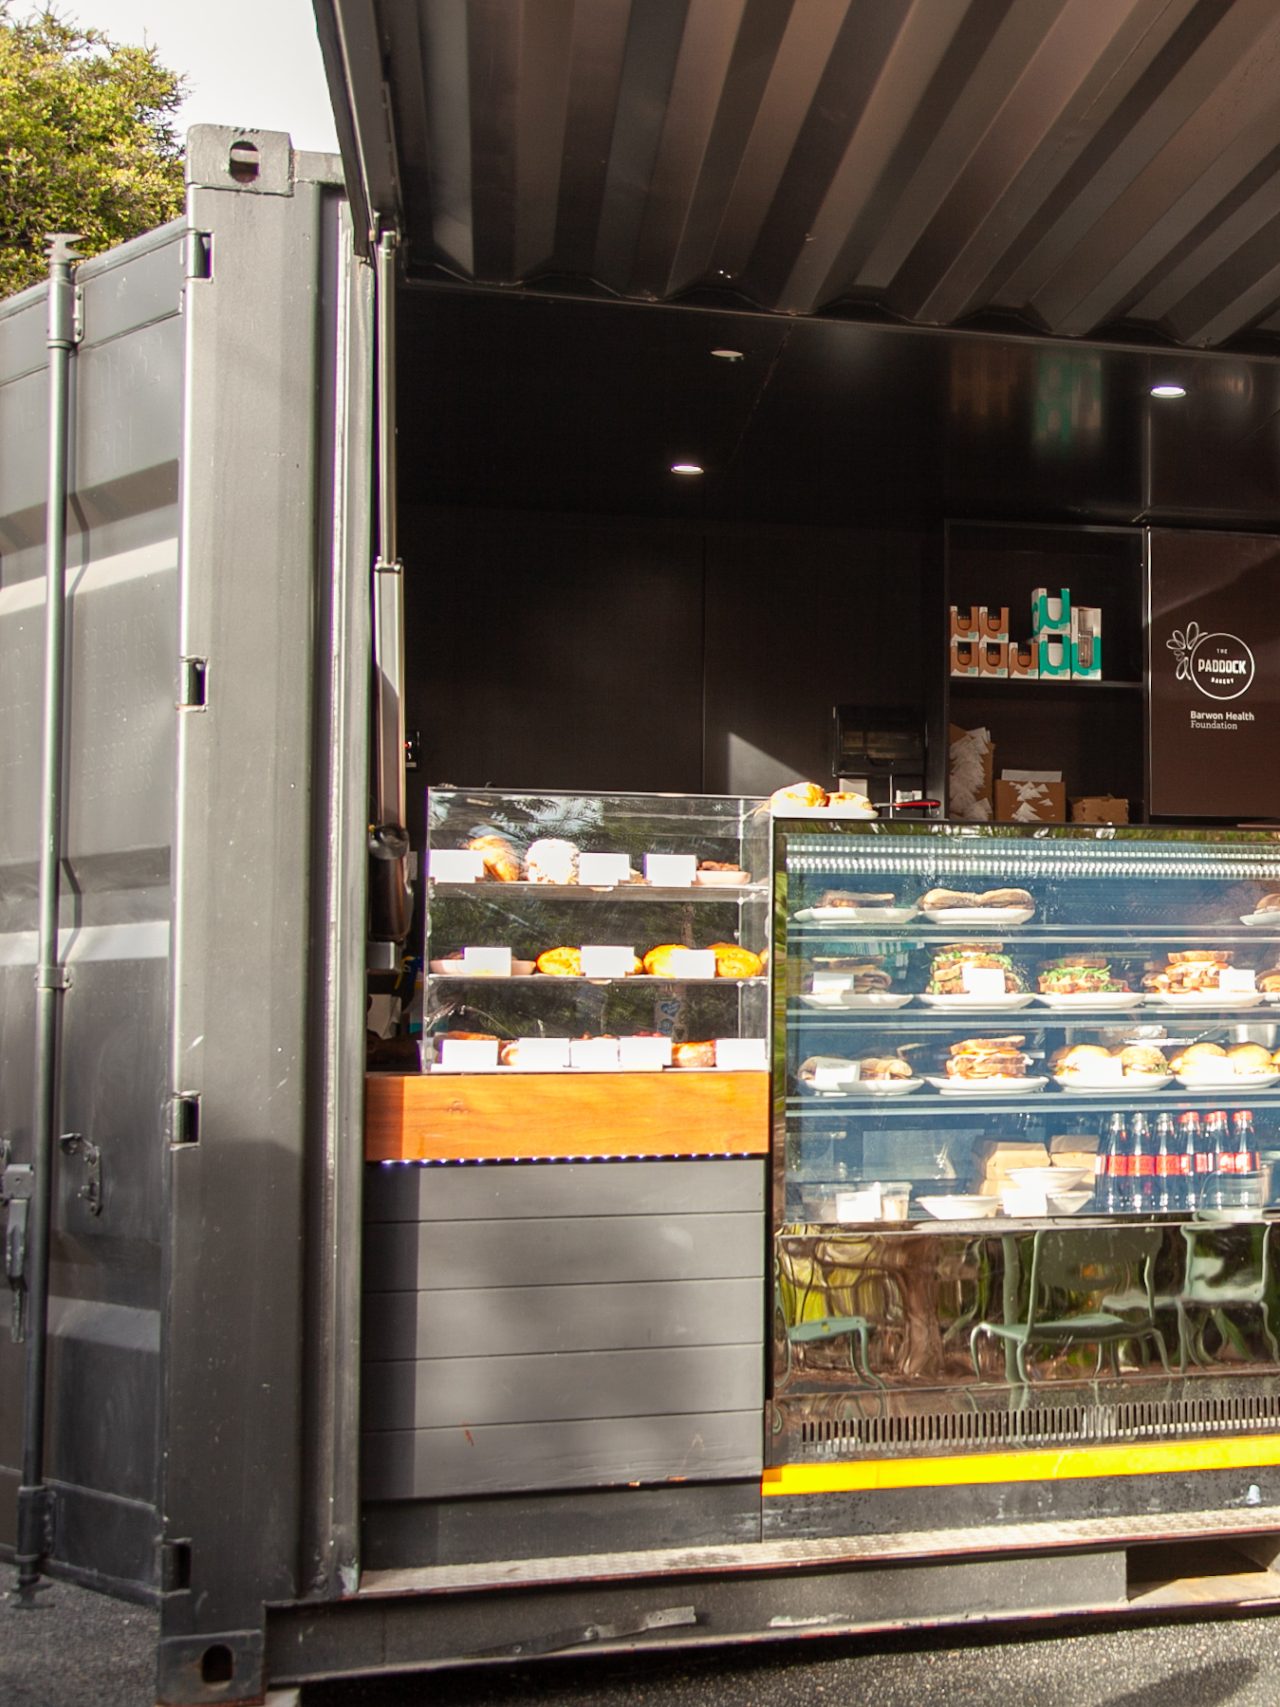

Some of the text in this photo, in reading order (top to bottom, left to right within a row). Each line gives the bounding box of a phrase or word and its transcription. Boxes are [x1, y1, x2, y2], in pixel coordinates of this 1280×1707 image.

[1198, 659, 1247, 674] PADDOCK
[1191, 711, 1254, 720] Barwon Health
[1191, 721, 1237, 729] Foundation
